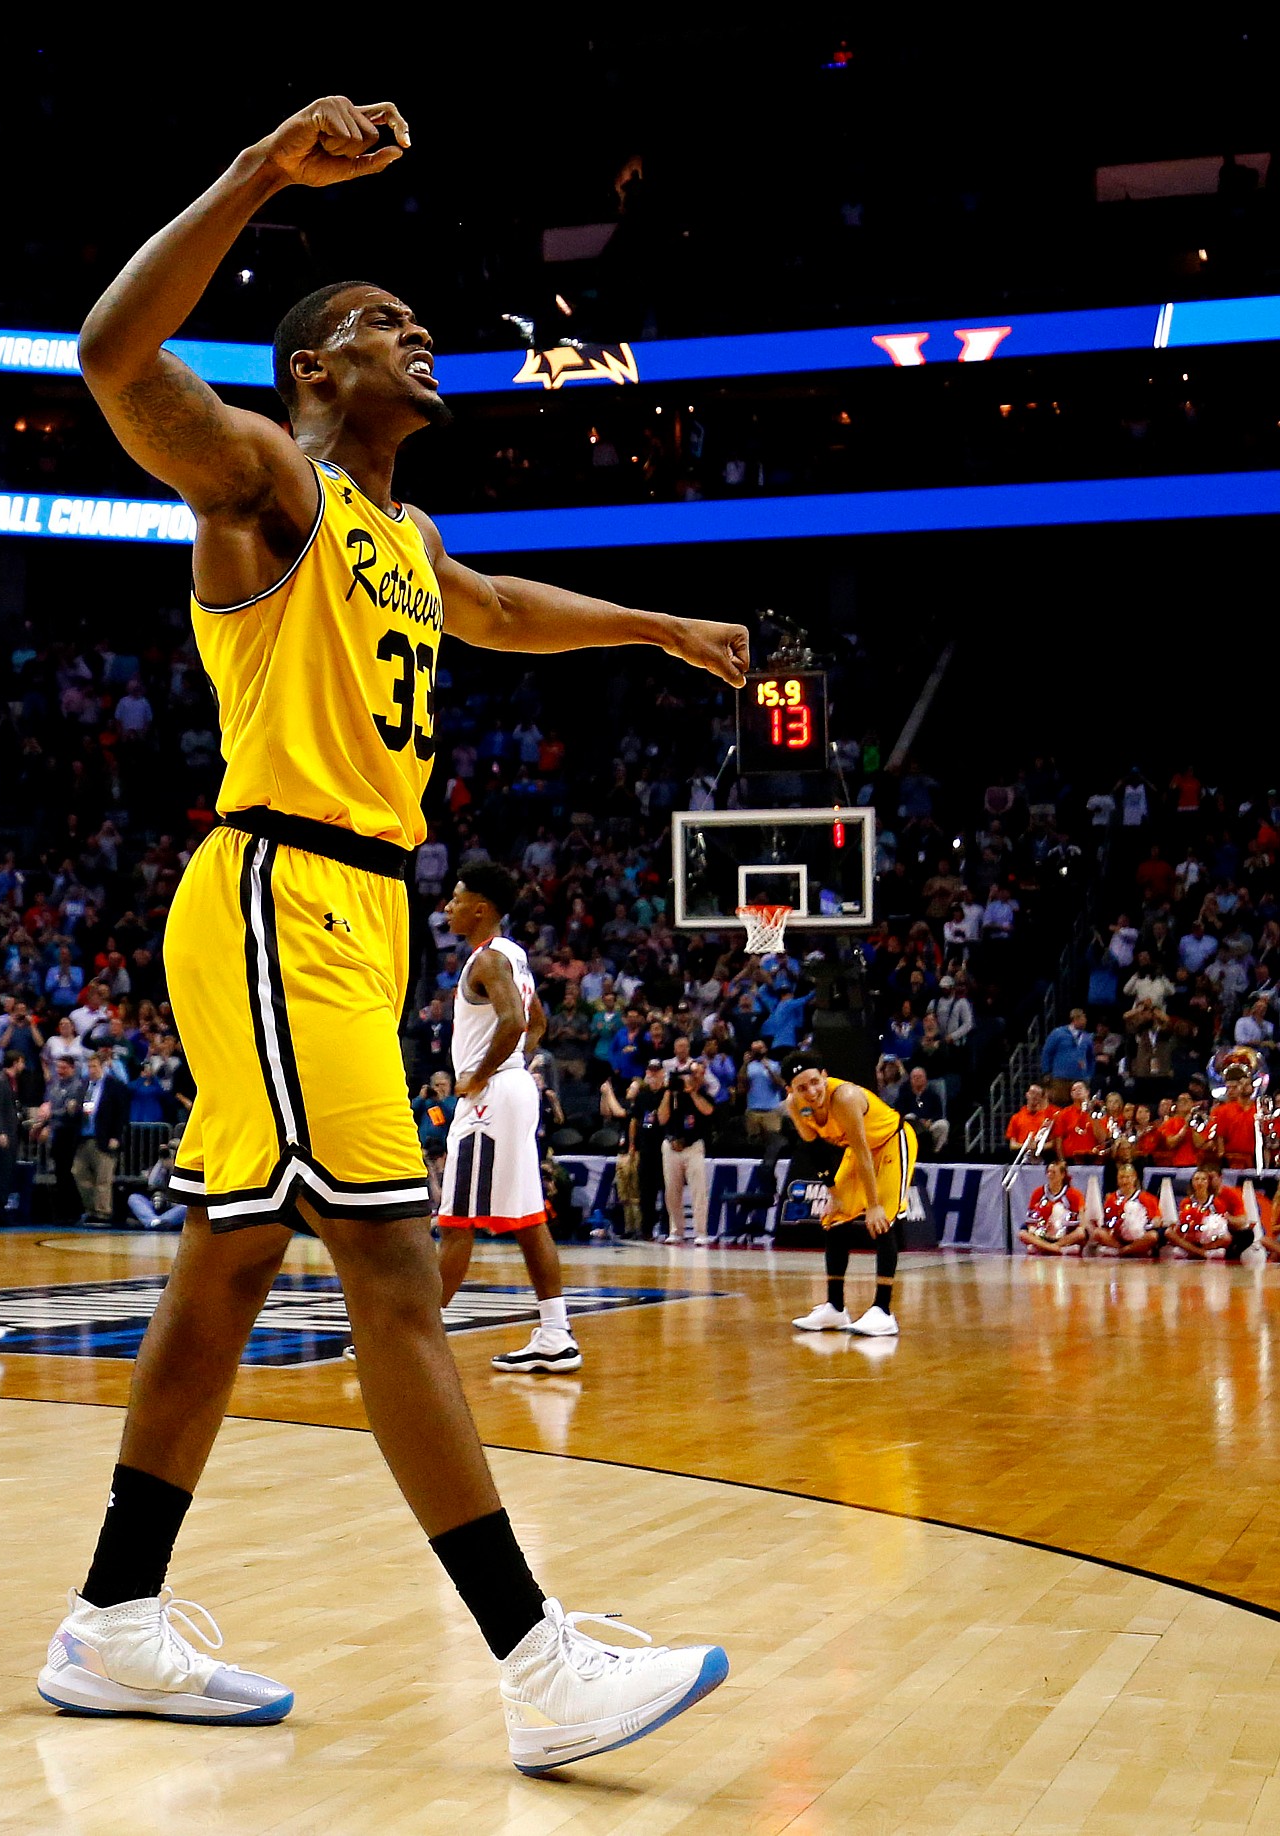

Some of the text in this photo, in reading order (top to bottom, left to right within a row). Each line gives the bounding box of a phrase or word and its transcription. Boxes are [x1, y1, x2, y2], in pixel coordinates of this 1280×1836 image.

[47, 498, 198, 541] CHAMPIO
[372, 629, 436, 762] 33
[757, 680, 801, 707] 15.9
[772, 705, 811, 749] 13
